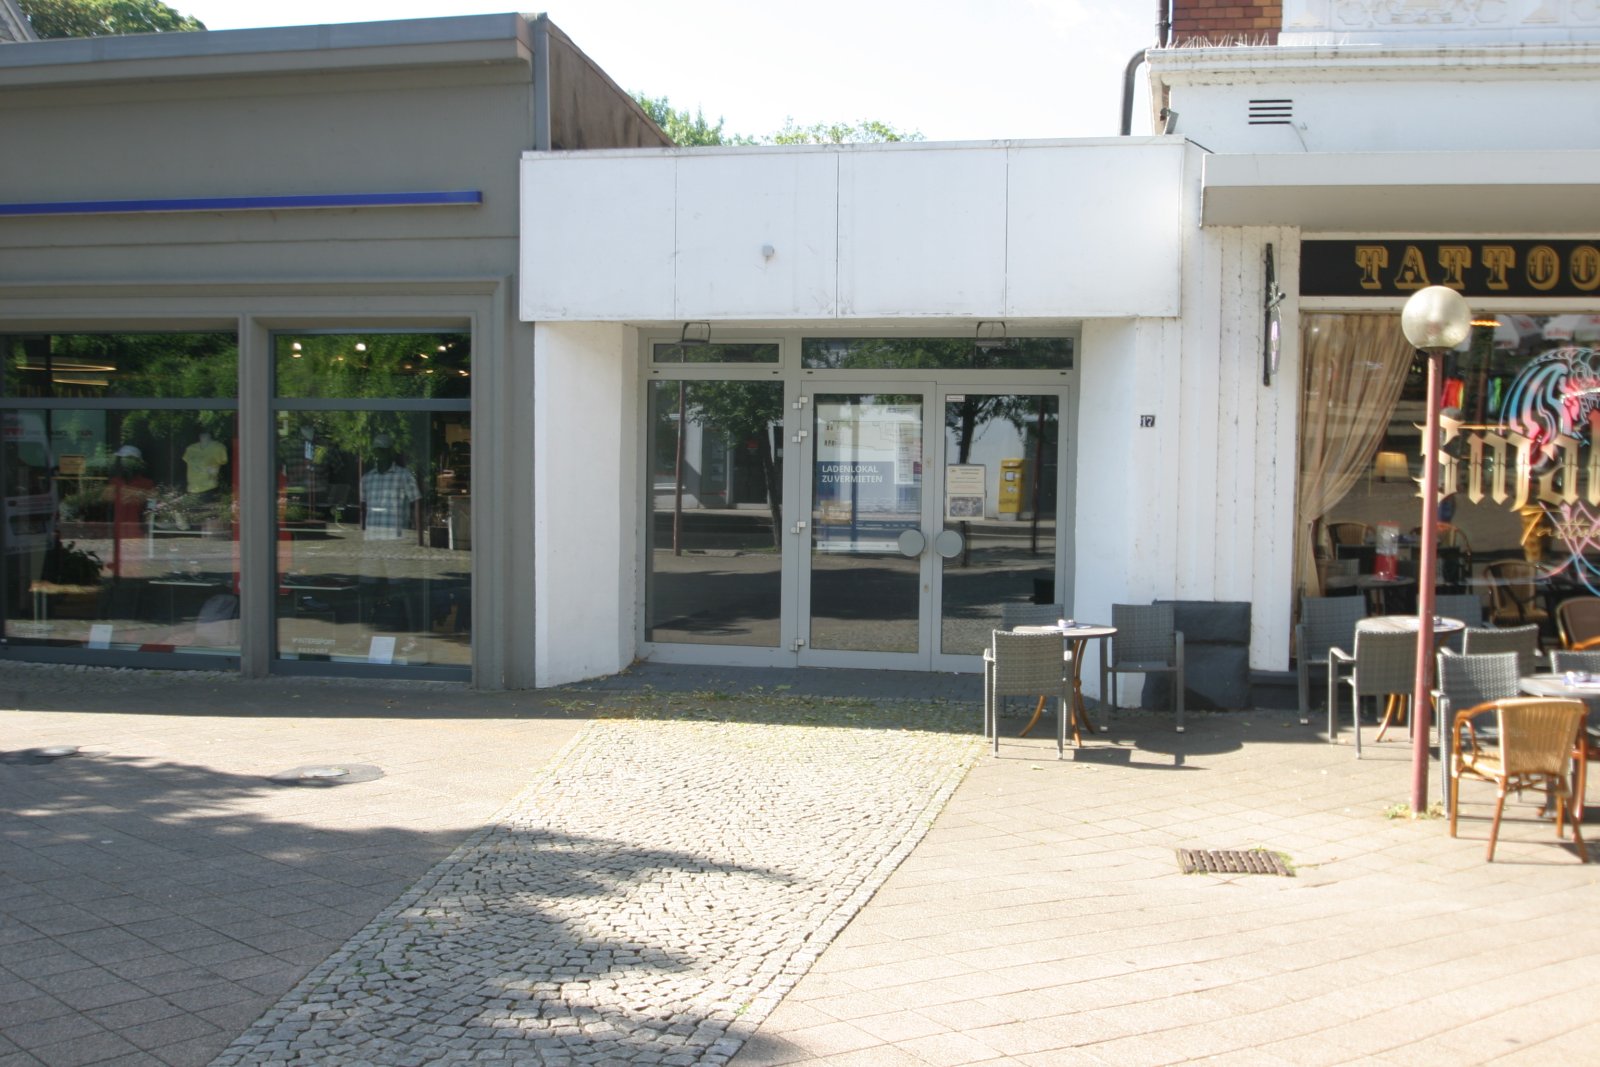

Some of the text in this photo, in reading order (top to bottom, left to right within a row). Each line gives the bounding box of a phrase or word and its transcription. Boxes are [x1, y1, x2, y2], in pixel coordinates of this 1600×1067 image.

[1355, 245, 1600, 290] TATTOO
[1141, 416, 1154, 428] 17
[822, 465, 878, 473] LADENLOKAL
[822, 475, 883, 483] ZU VERMIETEN
